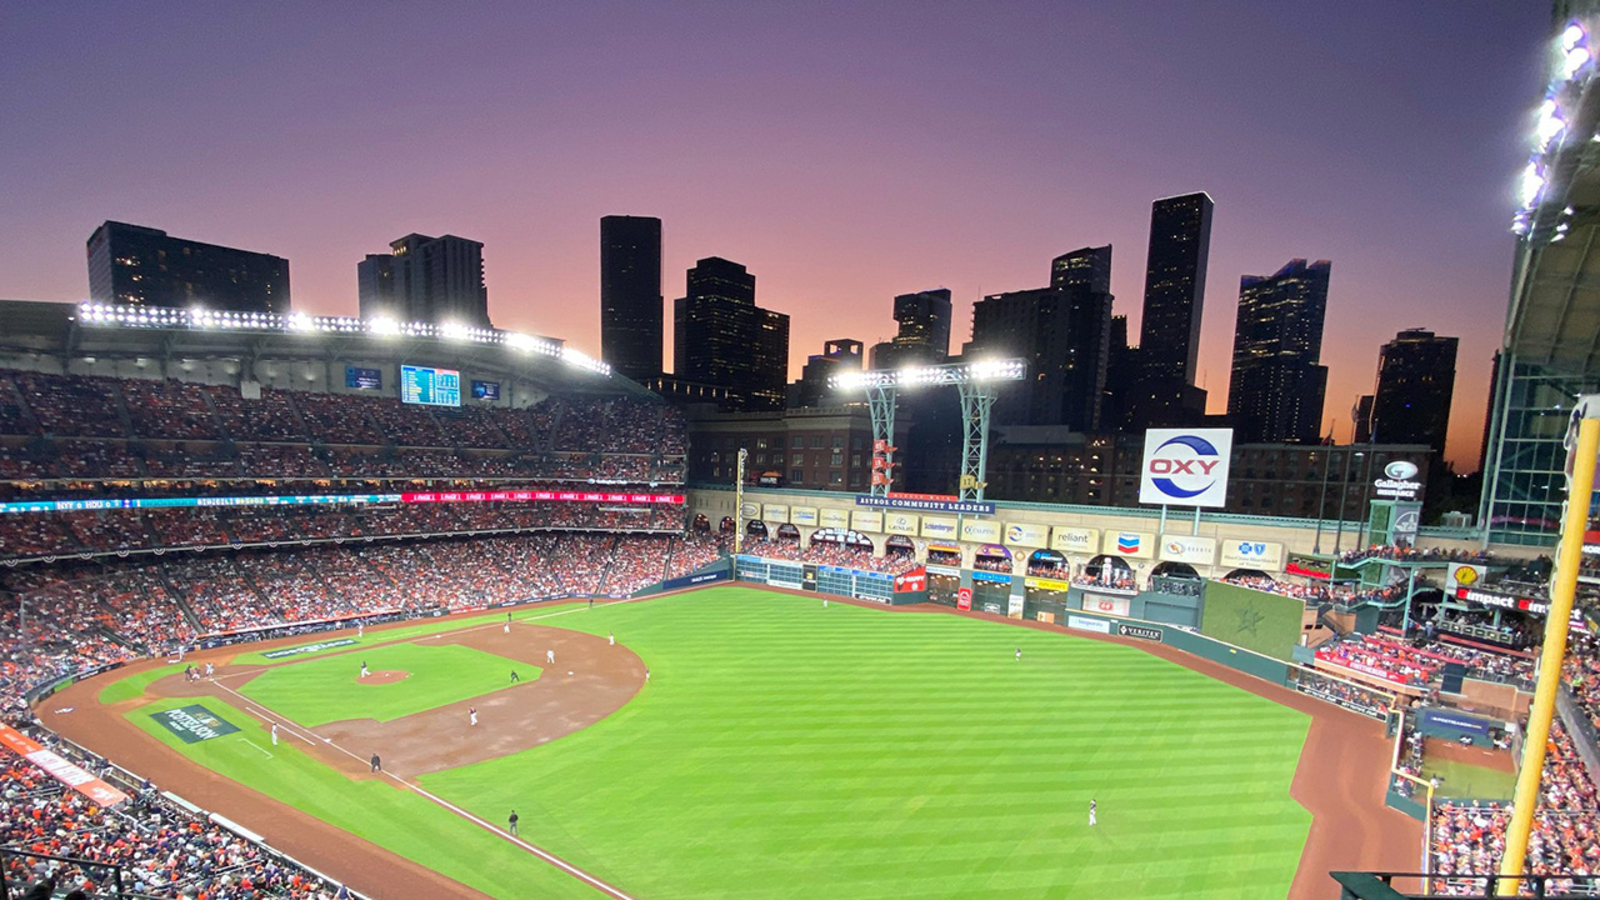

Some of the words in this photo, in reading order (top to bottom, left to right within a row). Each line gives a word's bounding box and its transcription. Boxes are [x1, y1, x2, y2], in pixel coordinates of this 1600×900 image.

[1150, 459, 1220, 475] OXY
[1374, 479, 1421, 490] Gallagher
[1377, 489, 1415, 497] INSURANCE
[860, 498, 889, 506] ASTROS
[891, 499, 945, 509] COMMUNITY
[948, 503, 990, 512] LEADERS
[924, 522, 954, 532] Schlumberger
[1058, 532, 1088, 543] reliant
[1466, 589, 1515, 608] impact
[165, 708, 220, 740] POSTSEASON
